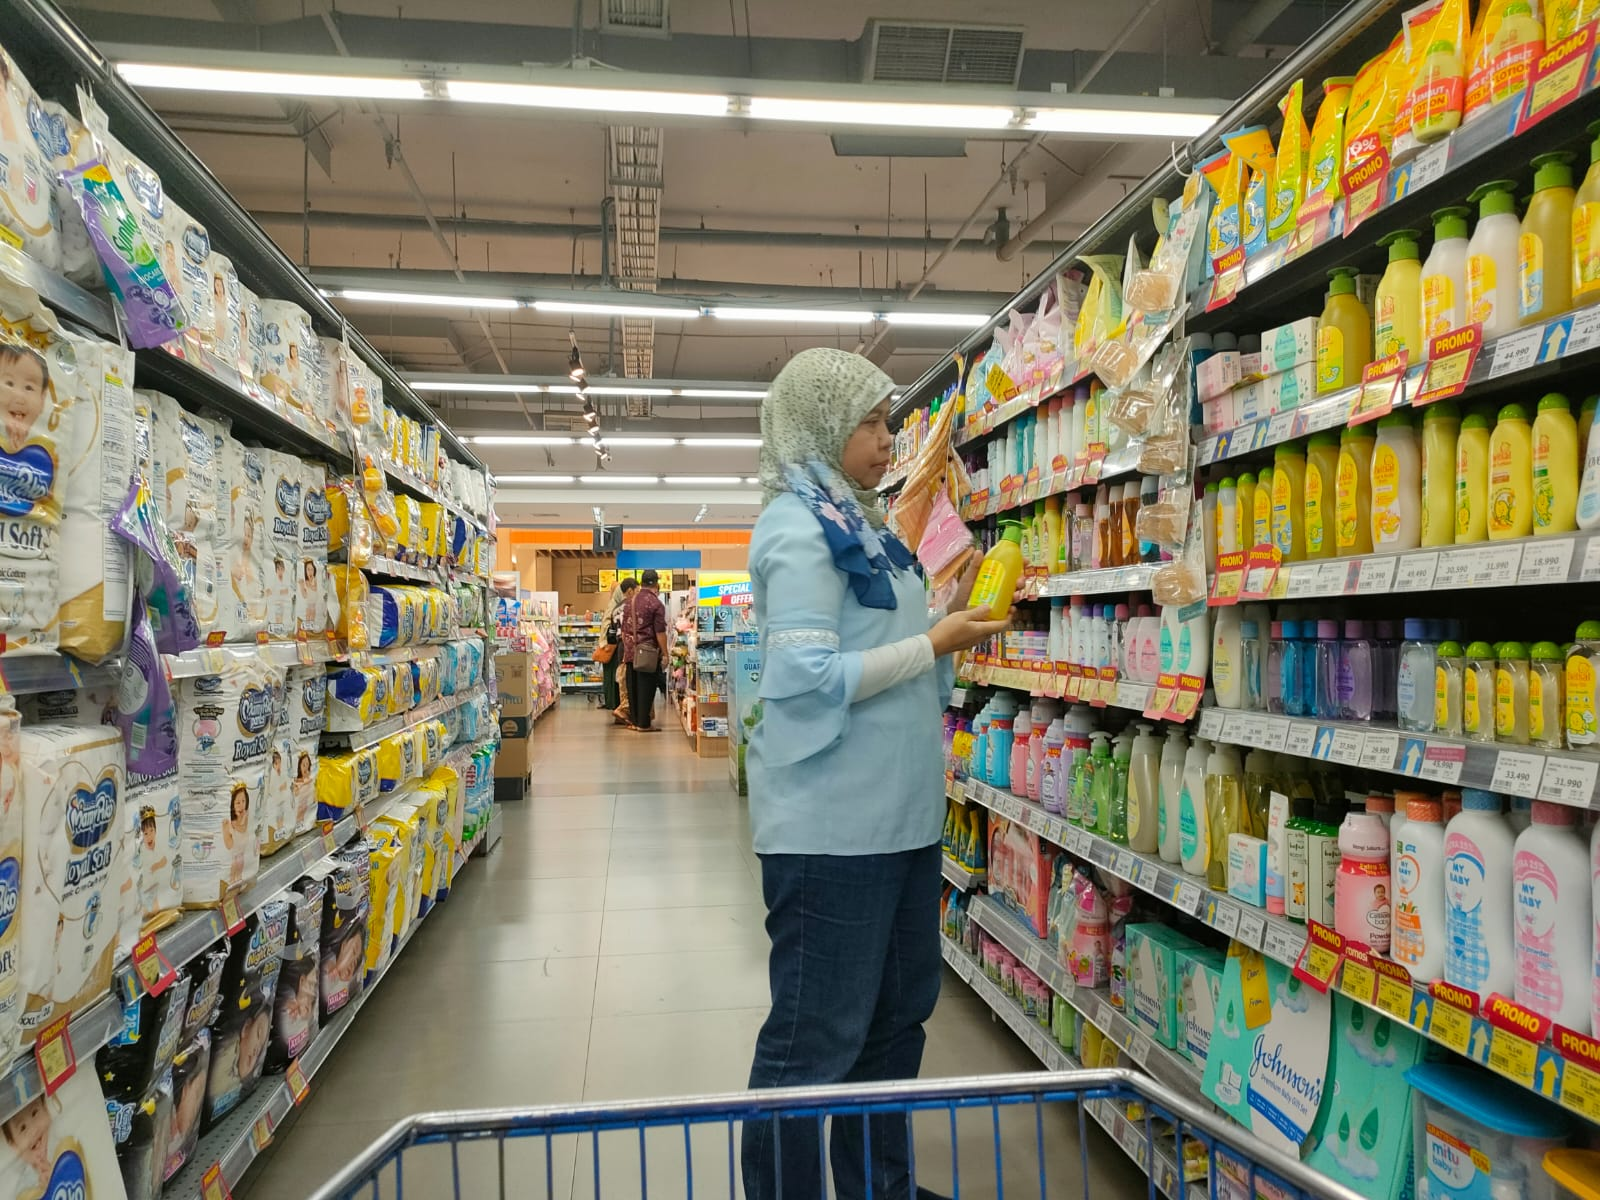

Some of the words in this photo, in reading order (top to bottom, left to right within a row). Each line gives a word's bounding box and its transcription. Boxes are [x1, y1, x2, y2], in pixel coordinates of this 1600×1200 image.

[1538, 29, 1589, 72] PROMO
[1348, 155, 1383, 189] PROMO
[1219, 251, 1242, 271] PROMO
[1435, 329, 1475, 354] PROMO
[1367, 357, 1400, 379] PROMO
[9, 523, 43, 552] Soft
[1219, 554, 1244, 567] PROMO
[718, 583, 750, 596] SPECIAL
[1181, 676, 1201, 689] PROMO
[233, 738, 257, 761] Royal
[1554, 777, 1583, 789] 31,990
[1452, 863, 1464, 874] MY
[1521, 883, 1535, 895] MY
[135, 936, 154, 959] PROMO
[1312, 924, 1341, 948] PROMO
[1345, 947, 1368, 962] romosi
[1373, 960, 1409, 981] PROMO
[1434, 983, 1473, 1009] PROMO
[20, 1011, 35, 1026] XXL
[1492, 999, 1540, 1033] PROMO
[41, 1017, 67, 1044] PROMO
[1249, 1032, 1321, 1107] Johnson's
[1260, 1072, 1282, 1094] Premium
[1281, 1086, 1294, 1105] Baby
[1292, 1093, 1301, 1111] Gift
[1299, 1102, 1308, 1116] Set
[1432, 1141, 1460, 1166] mitu
[203, 1163, 220, 1186] PROMO
[1432, 1156, 1452, 1175] baby
